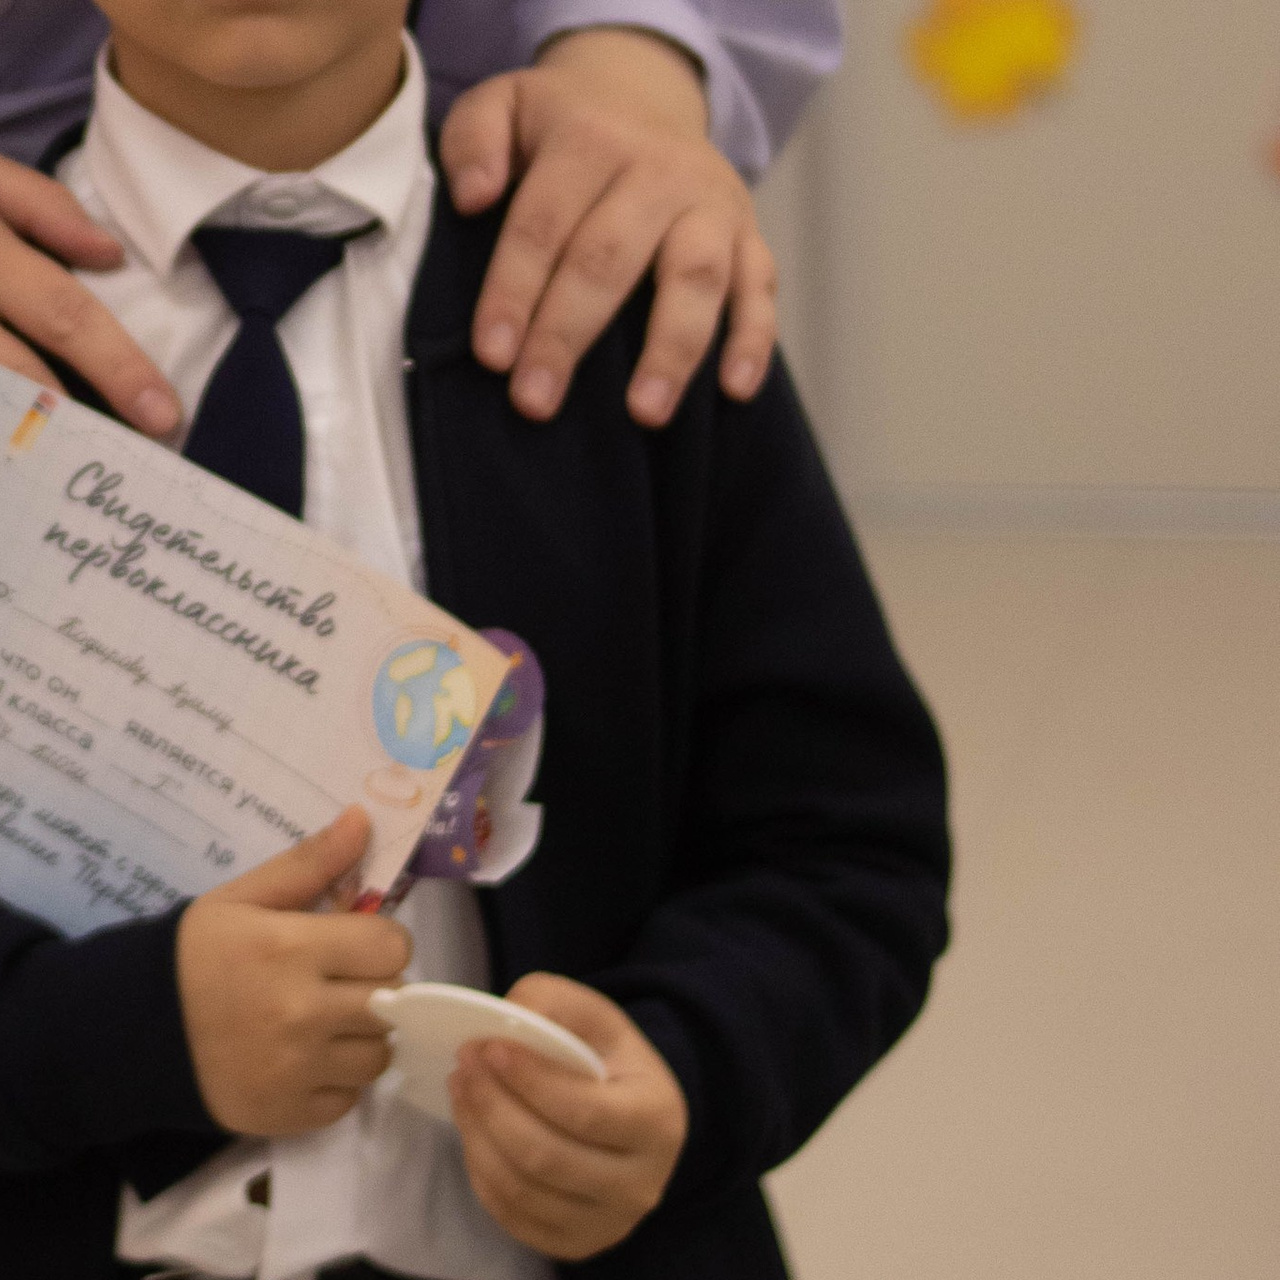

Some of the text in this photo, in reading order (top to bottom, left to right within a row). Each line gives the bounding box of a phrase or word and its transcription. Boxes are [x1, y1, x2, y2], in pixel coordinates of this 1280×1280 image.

[65, 461, 337, 638] Свидетельство
[43, 524, 320, 695] первоклассника
[0, 648, 43, 684] что
[45, 675, 82, 705] он
[123, 719, 235, 796] является
[5, 693, 95, 753] класса
[32, 810, 110, 865] может
[113, 855, 129, 874] с
[203, 840, 236, 869] №
